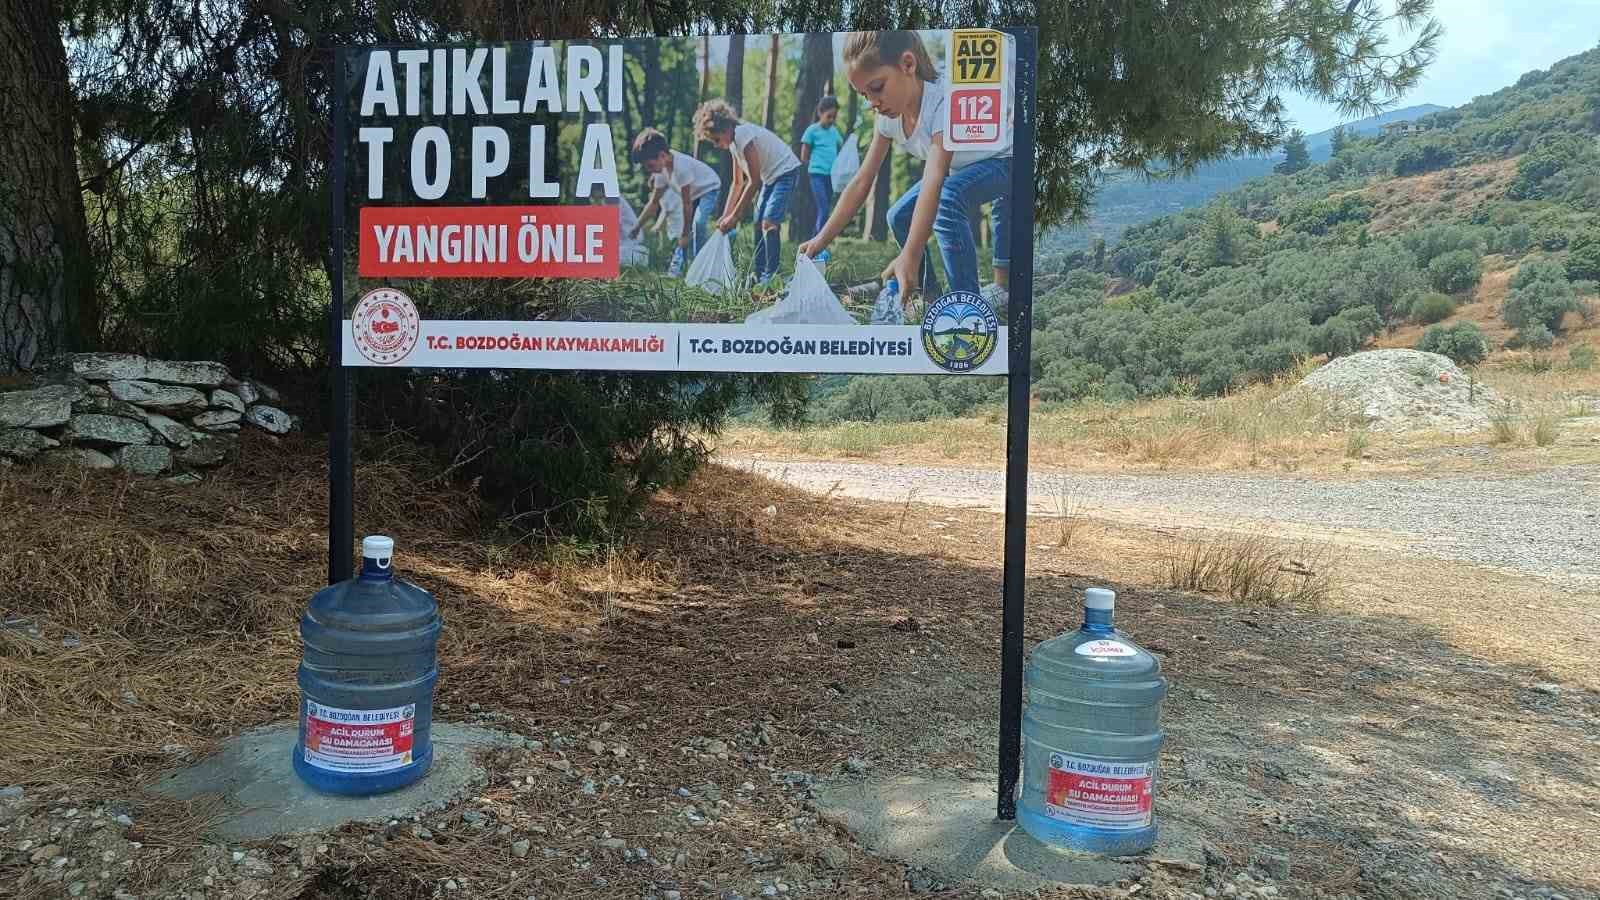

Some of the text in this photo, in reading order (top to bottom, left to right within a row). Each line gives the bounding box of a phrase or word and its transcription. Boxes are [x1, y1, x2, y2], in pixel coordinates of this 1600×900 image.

[957, 39, 997, 57] ALO
[360, 44, 624, 116] ATIKLARI
[957, 57, 997, 79] 177
[958, 95, 993, 121] 112
[359, 123, 620, 200] TOPLA
[373, 214, 605, 264] YANGINI ÖNLE
[426, 332, 665, 353] T.C. BOZDOĞAN KAYMAKAMLIĞI
[689, 335, 913, 357] T.C. BOZDOĞAN BELEDİYESİ
